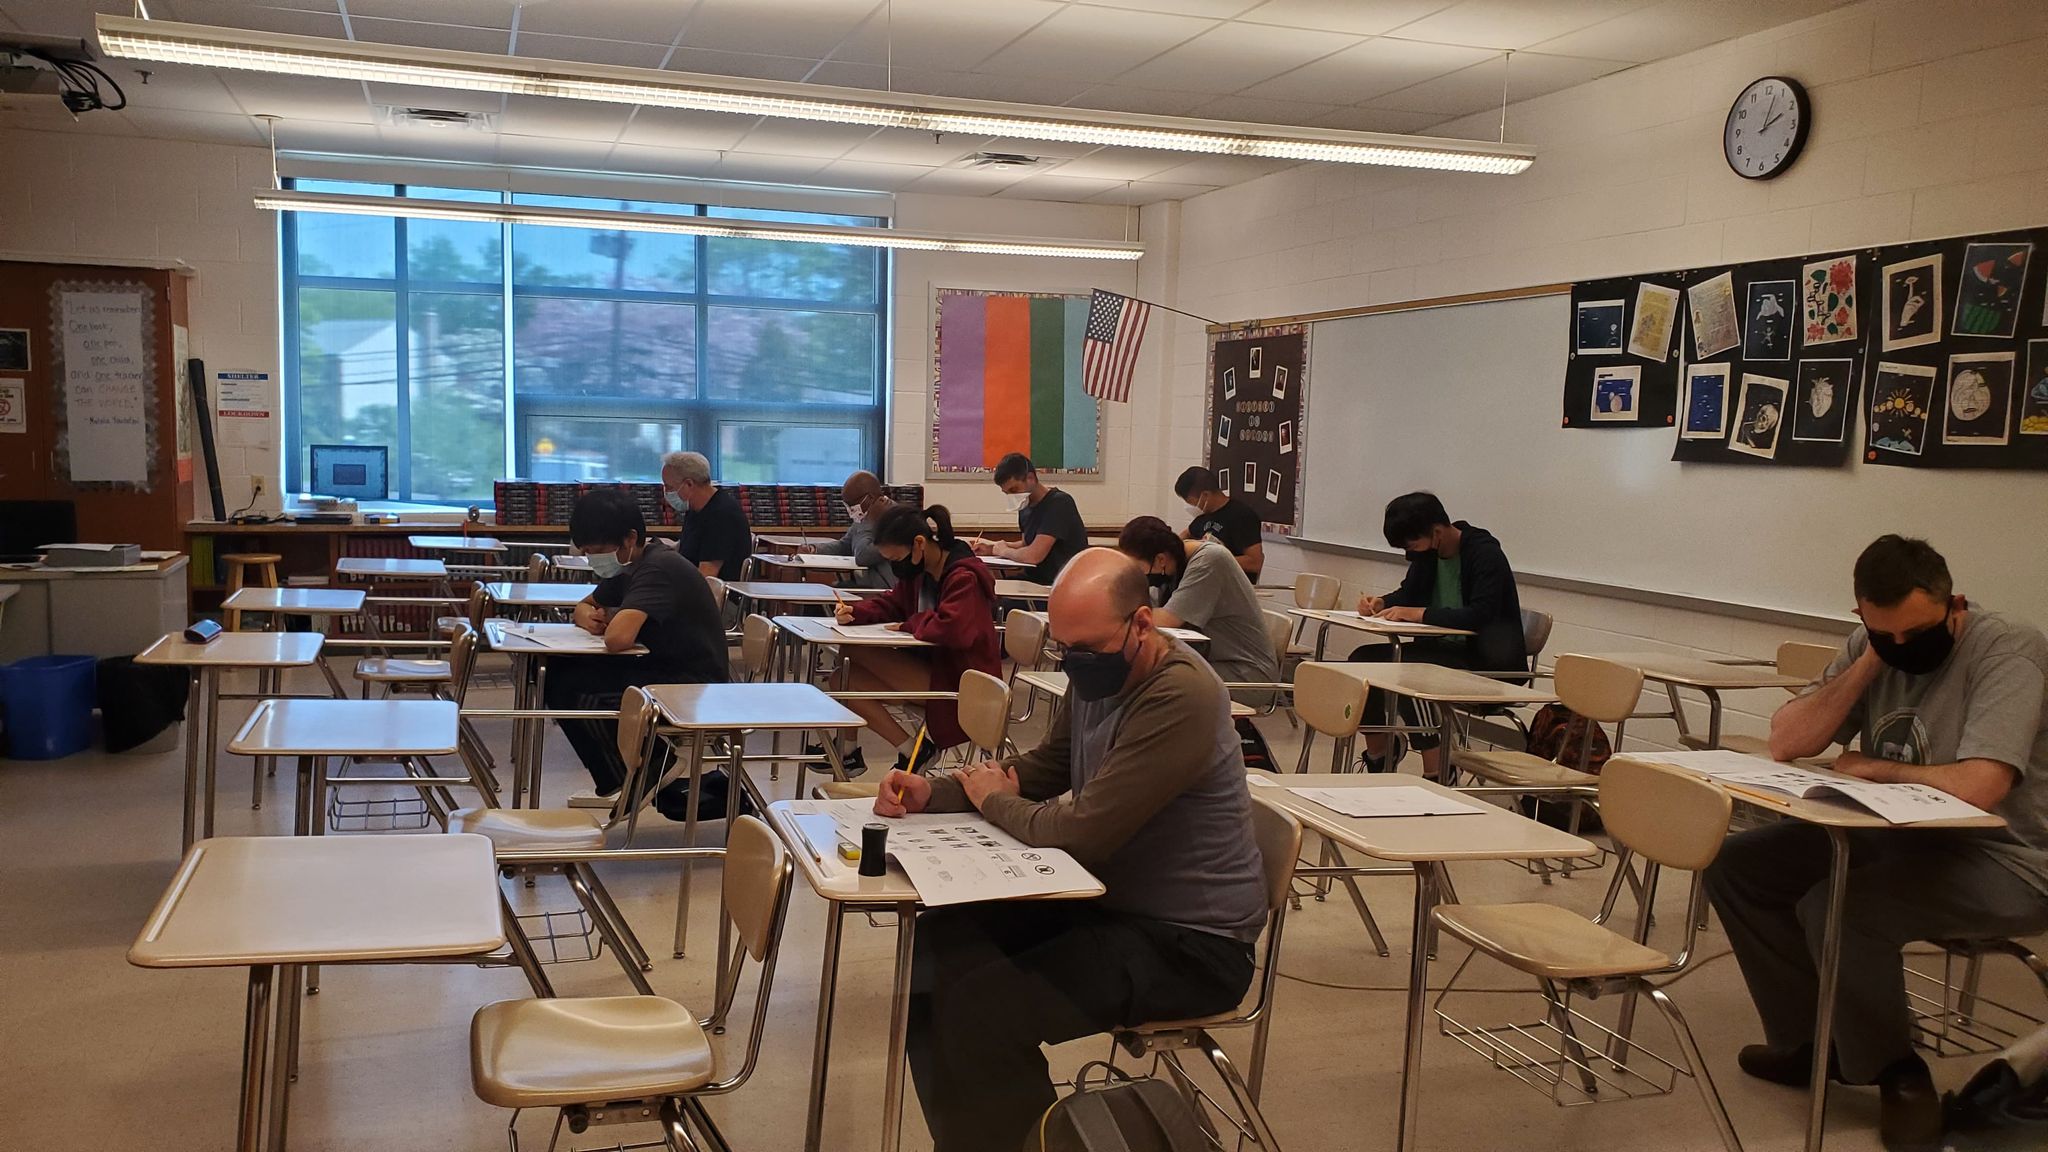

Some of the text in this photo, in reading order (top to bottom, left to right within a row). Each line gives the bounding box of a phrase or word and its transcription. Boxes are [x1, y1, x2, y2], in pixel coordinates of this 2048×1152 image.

[1765, 85, 1774, 96] 12
[1780, 88, 1785, 97] 1
[1750, 93, 1757, 103] 11
[1789, 100, 1795, 110] 2
[1738, 109, 1747, 120] 10
[1790, 119, 1796, 130] 3
[1735, 129, 1741, 138] 9
[1783, 137, 1790, 147] 4
[1736, 145, 1742, 155] 8
[1745, 158, 1751, 168] 7
[1773, 153, 1780, 164] 5
[1758, 161, 1765, 171] 6
